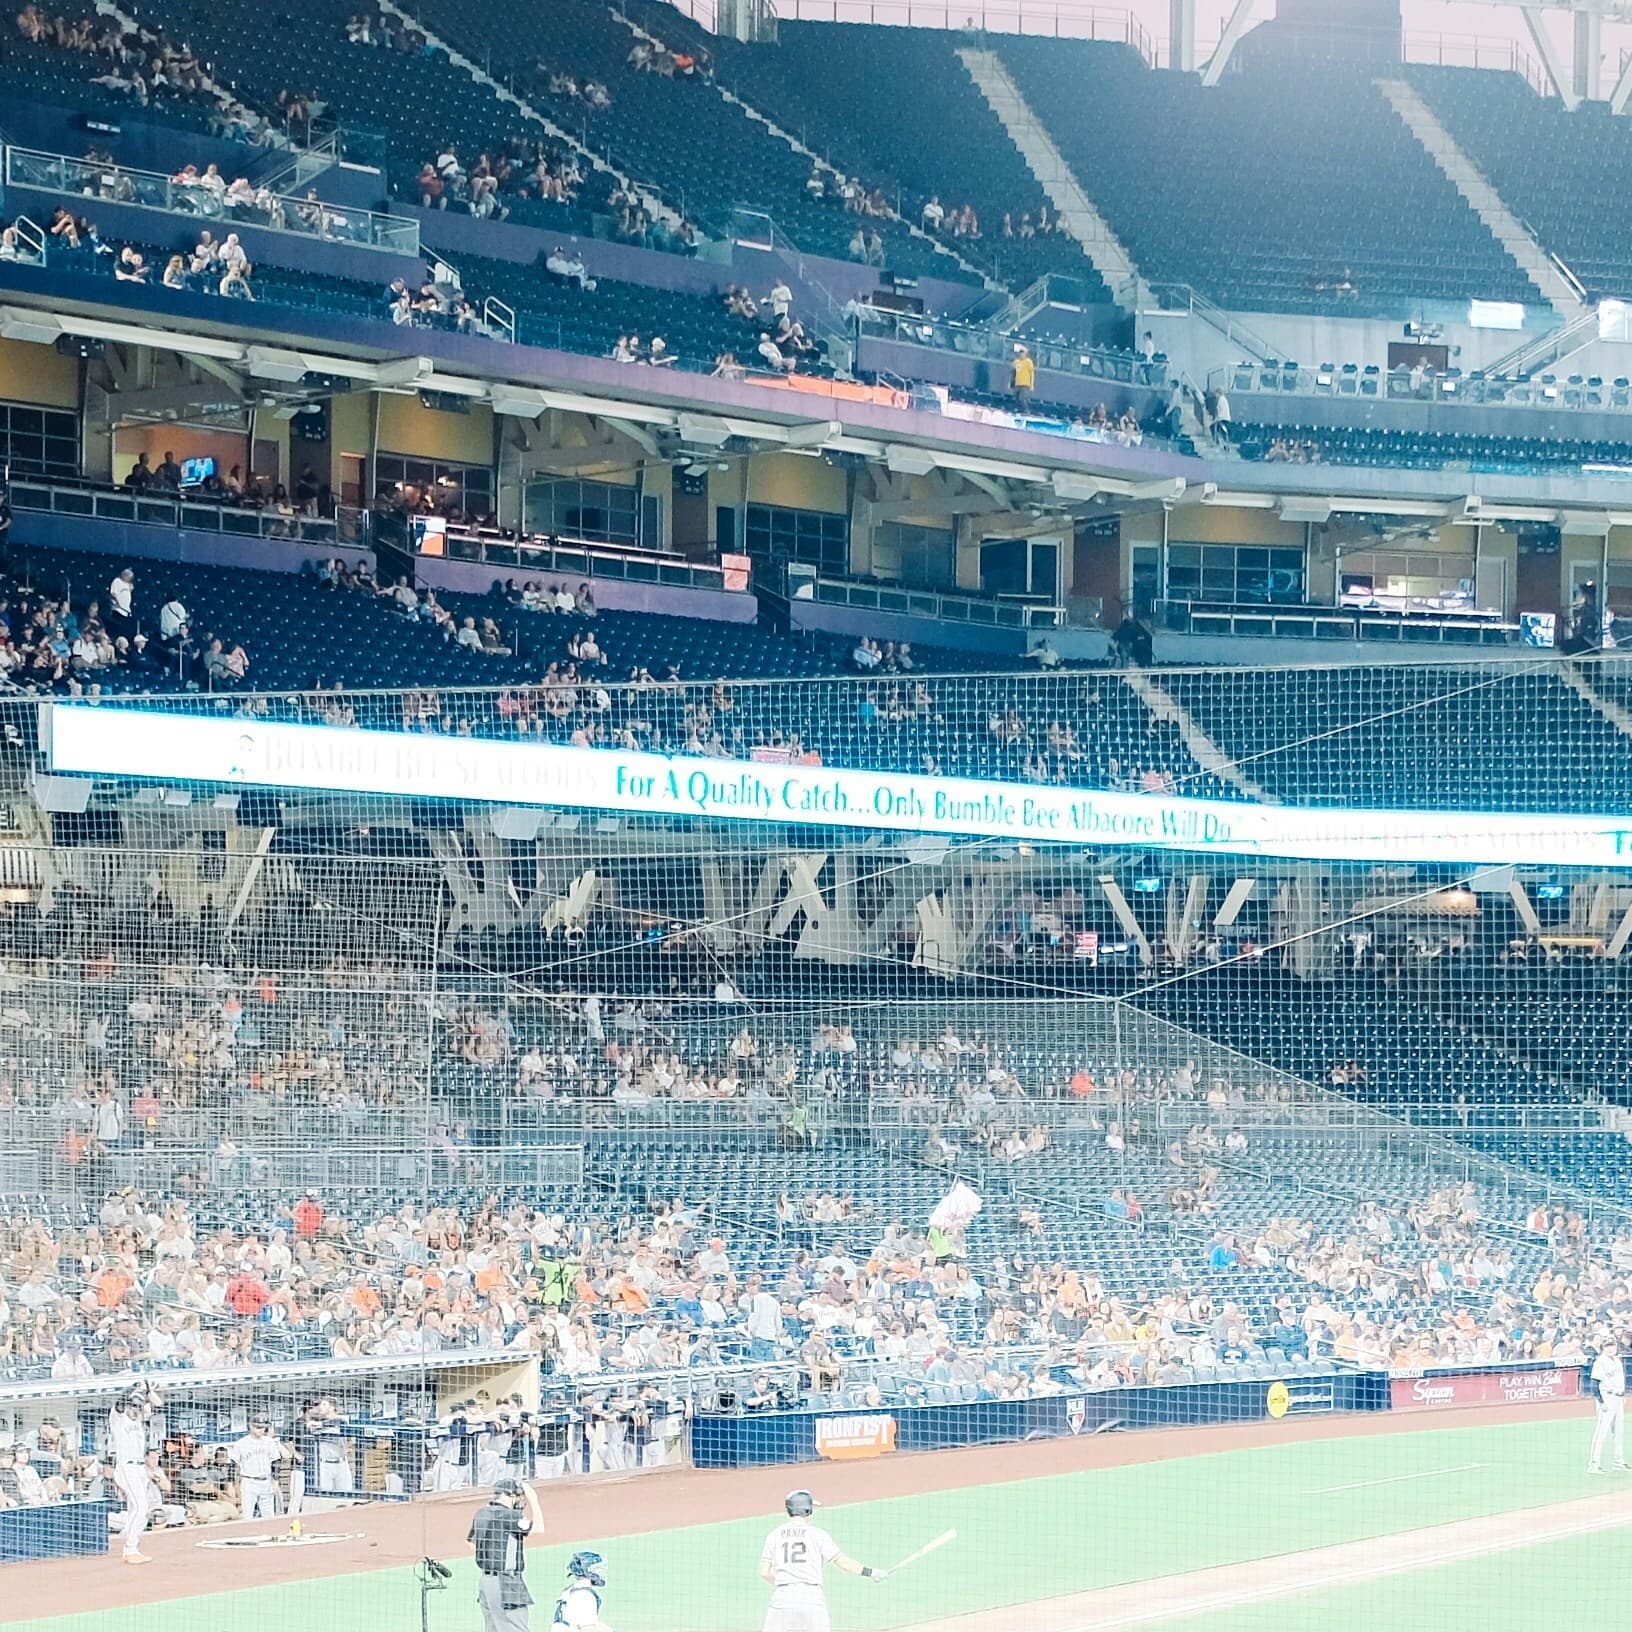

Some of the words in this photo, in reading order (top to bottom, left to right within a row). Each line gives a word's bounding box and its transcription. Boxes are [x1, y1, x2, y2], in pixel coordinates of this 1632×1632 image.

[616, 766, 655, 799] For
[663, 769, 680, 799] A
[687, 771, 776, 816] Quality
[934, 790, 1016, 825] Bumble
[1023, 798, 1061, 828] Bee
[1070, 801, 1154, 836] Albacore
[1161, 809, 1198, 837] Will
[782, 1542, 807, 1564] 12
